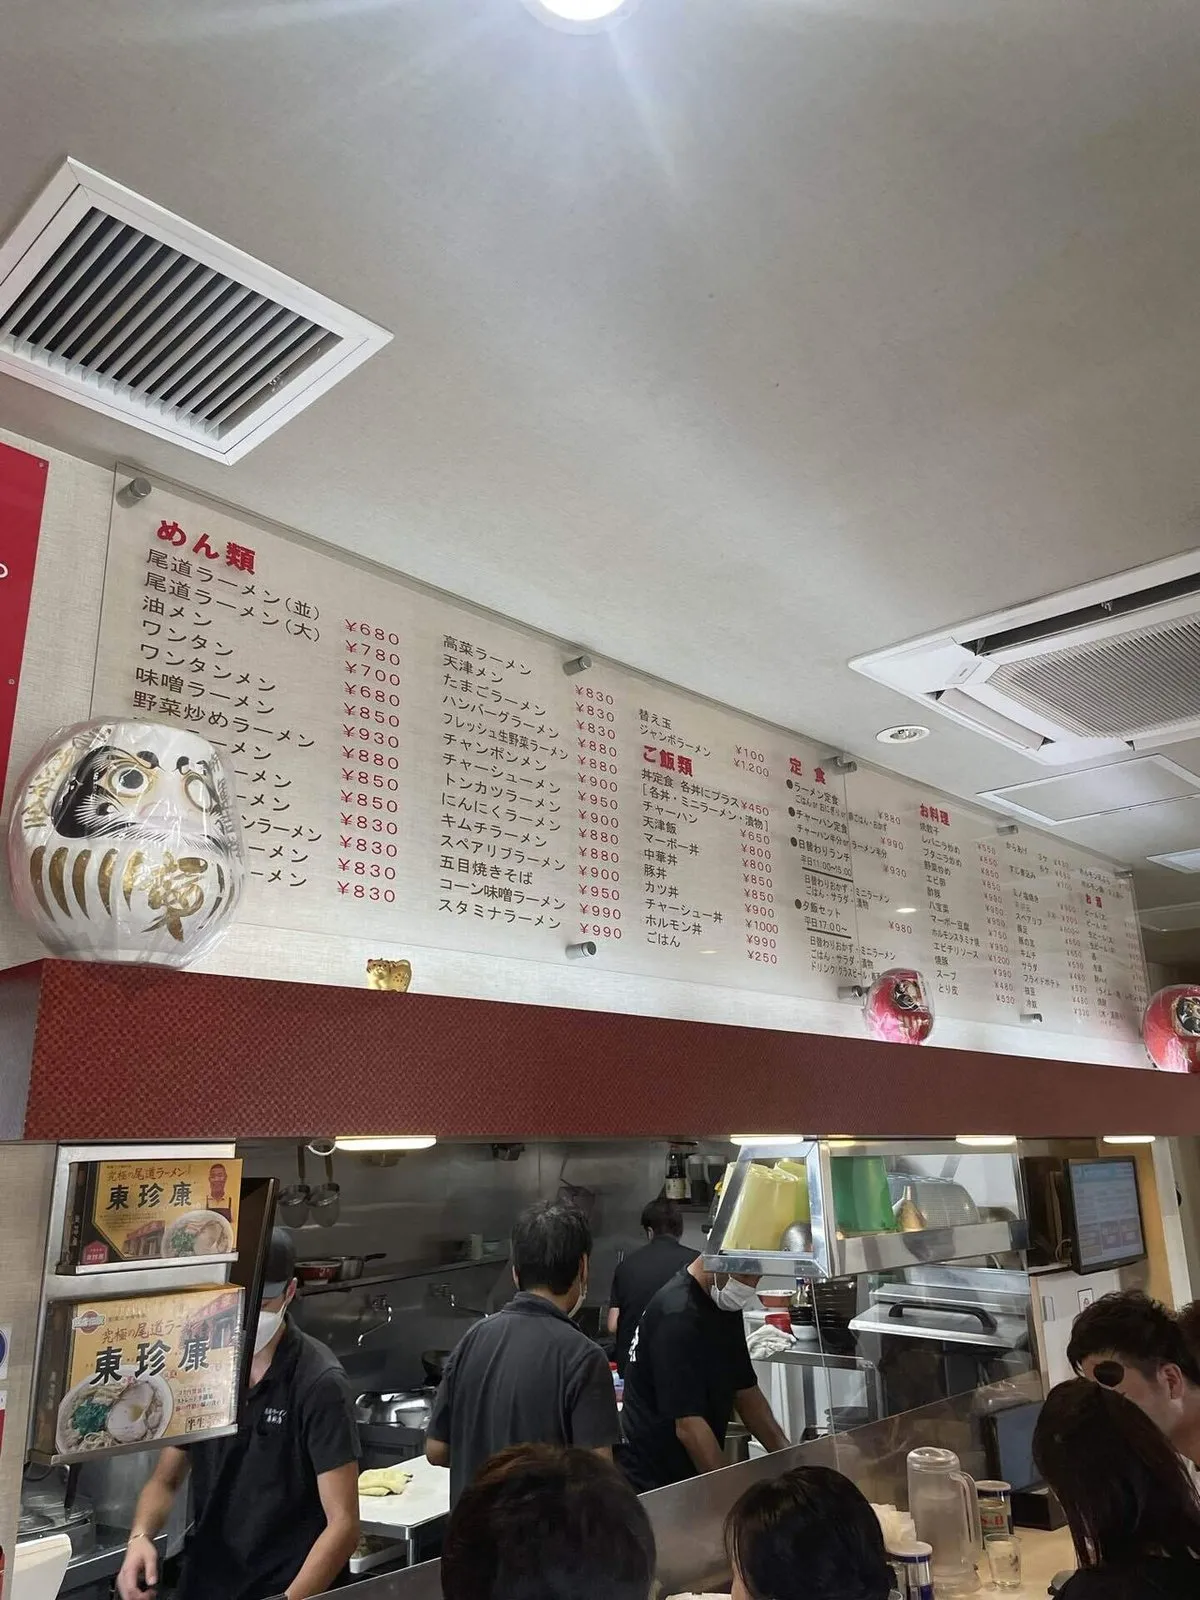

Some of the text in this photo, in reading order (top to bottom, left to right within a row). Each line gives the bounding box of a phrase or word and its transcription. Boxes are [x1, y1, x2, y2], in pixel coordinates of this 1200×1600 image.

[156, 519, 256, 576] めん類
[142, 596, 400, 687] 油メン ¥700
[345, 619, 400, 646] ¥680
[345, 640, 400, 666] ¥780
[142, 620, 400, 707] ワンタン ¥680
[443, 634, 614, 705] 高菜ラーメン ¥830
[140, 643, 400, 728] ワンタンメン ¥850
[443, 653, 615, 722] 天津メン ¥830
[443, 673, 616, 740] たまごラーメン ¥830
[135, 667, 399, 749] 味噌ラーメン ¥930
[443, 694, 617, 757] ハンバーグラーメン ¥880
[132, 690, 315, 748] 野菜炒めラーメン
[342, 746, 399, 770] ¥880
[443, 713, 617, 775] フレッシュ生野菜ラーメン ¥880
[638, 708, 765, 763] 替え玉 ¥100
[639, 724, 711, 757] ジャンボラーメン
[341, 767, 399, 791] ¥850
[443, 733, 618, 792] チャンポンメン ¥900
[443, 752, 618, 810] チャーシューメン ¥950
[642, 744, 693, 777] ご飯類
[340, 790, 398, 813] ¥850
[442, 792, 619, 845] にんにくラーメン ¥880
[446, 772, 619, 828] トンカツラーメン ¥900
[340, 813, 398, 836] ¥830
[441, 813, 619, 863] キムチラーメン ¥880
[642, 800, 770, 845] チャーハン ¥650
[642, 815, 677, 836] 天津飯
[643, 832, 700, 856] マーボー丼
[339, 835, 398, 858] ¥830
[440, 834, 620, 882] スペアリブラーメン ¥900
[338, 858, 396, 880] ¥830
[439, 854, 620, 901] 五目焼きそば ¥950
[643, 863, 774, 903] 豚丼 ¥850
[644, 849, 773, 888] 中華丼 ¥850
[337, 881, 396, 903] ¥830
[440, 878, 622, 920] コーン味噌ラーメン ¥990
[645, 881, 775, 918] カツ丼 ¥900
[645, 898, 723, 924] チャーシュー丼
[438, 899, 622, 939] スタミナラーメン ¥990
[645, 914, 777, 949] ホルモン丼 ¥990
[646, 931, 777, 964] ごはん ¥250
[106, 1181, 192, 1211] 東珍康
[89, 1338, 210, 1386] 東珍康
